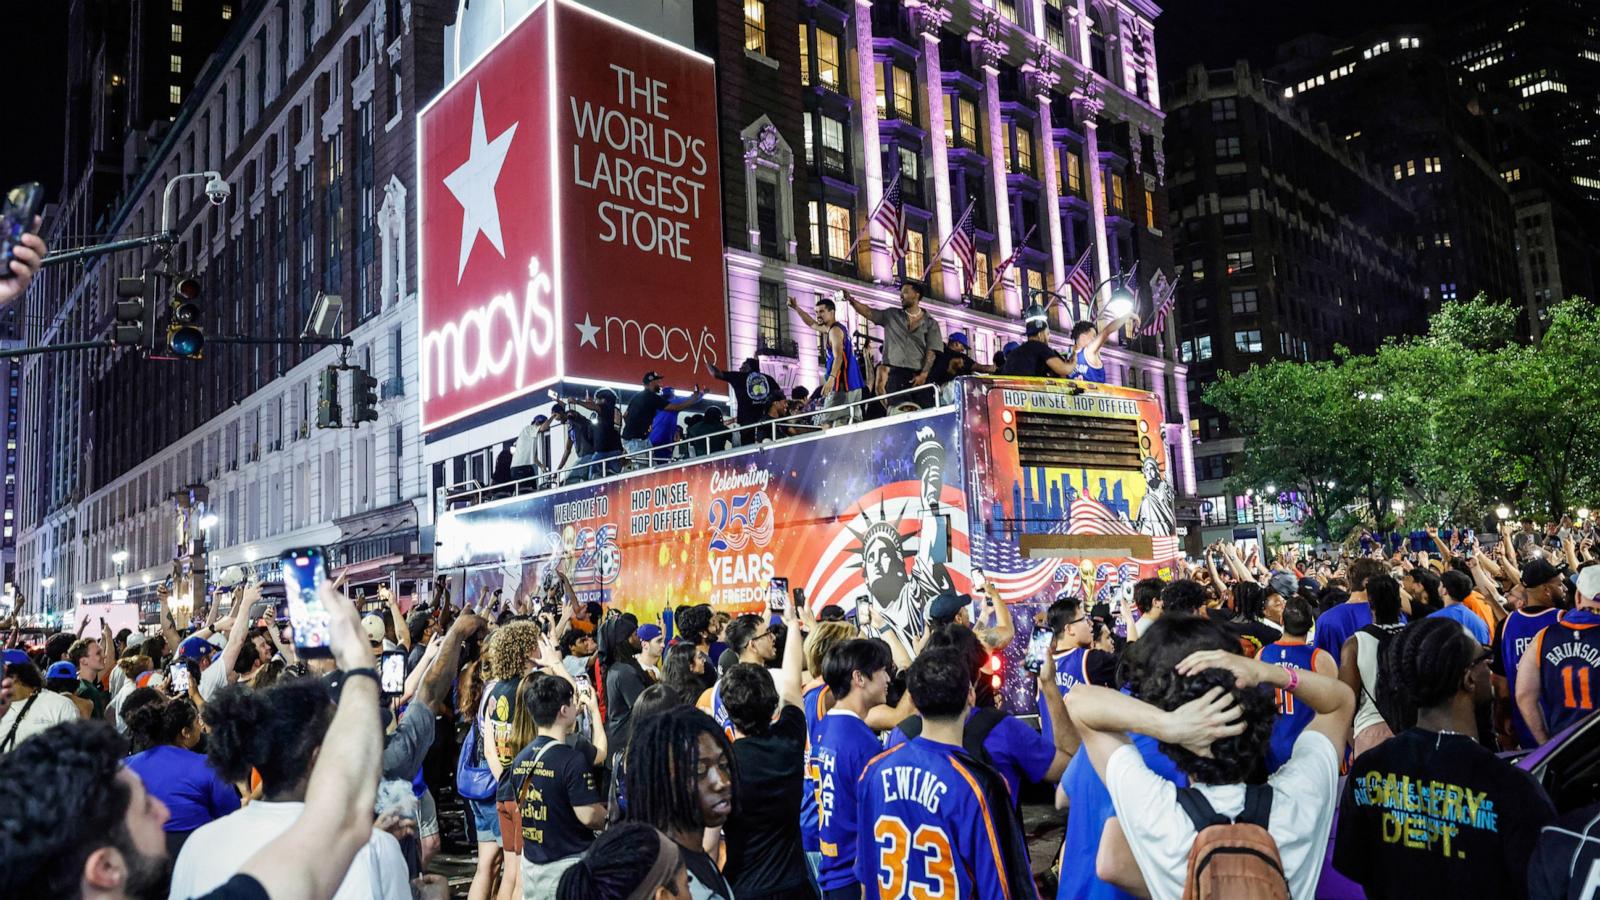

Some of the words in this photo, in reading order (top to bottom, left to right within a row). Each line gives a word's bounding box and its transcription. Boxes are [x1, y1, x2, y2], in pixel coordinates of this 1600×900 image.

[609, 63, 669, 120] THE
[570, 95, 706, 176] WORLD'S
[573, 144, 706, 219] LARGEST
[598, 201, 692, 262] STORE
[423, 256, 553, 402] macy's
[604, 315, 717, 374] macy's
[1004, 390, 1027, 406] HOP
[1031, 393, 1046, 407] ON
[1074, 396, 1095, 411] HOP
[1098, 399, 1116, 413] OFF
[1118, 400, 1139, 415] FEEL
[631, 489, 652, 512] HOP
[654, 485, 669, 508] ON
[710, 465, 770, 494] Celebrating
[554, 498, 596, 525] WELCOME
[596, 495, 608, 517] TO
[631, 513, 651, 536] HOP
[653, 510, 671, 533] OFF
[671, 507, 694, 531] FEEL
[708, 490, 775, 551] 250
[708, 552, 775, 586] YEARS
[711, 589, 720, 604] of
[1561, 665, 1593, 710] 11
[822, 754, 836, 827] HART
[881, 766, 948, 814] EWING
[1366, 771, 1488, 827] GALLERY
[874, 815, 960, 900] 33
